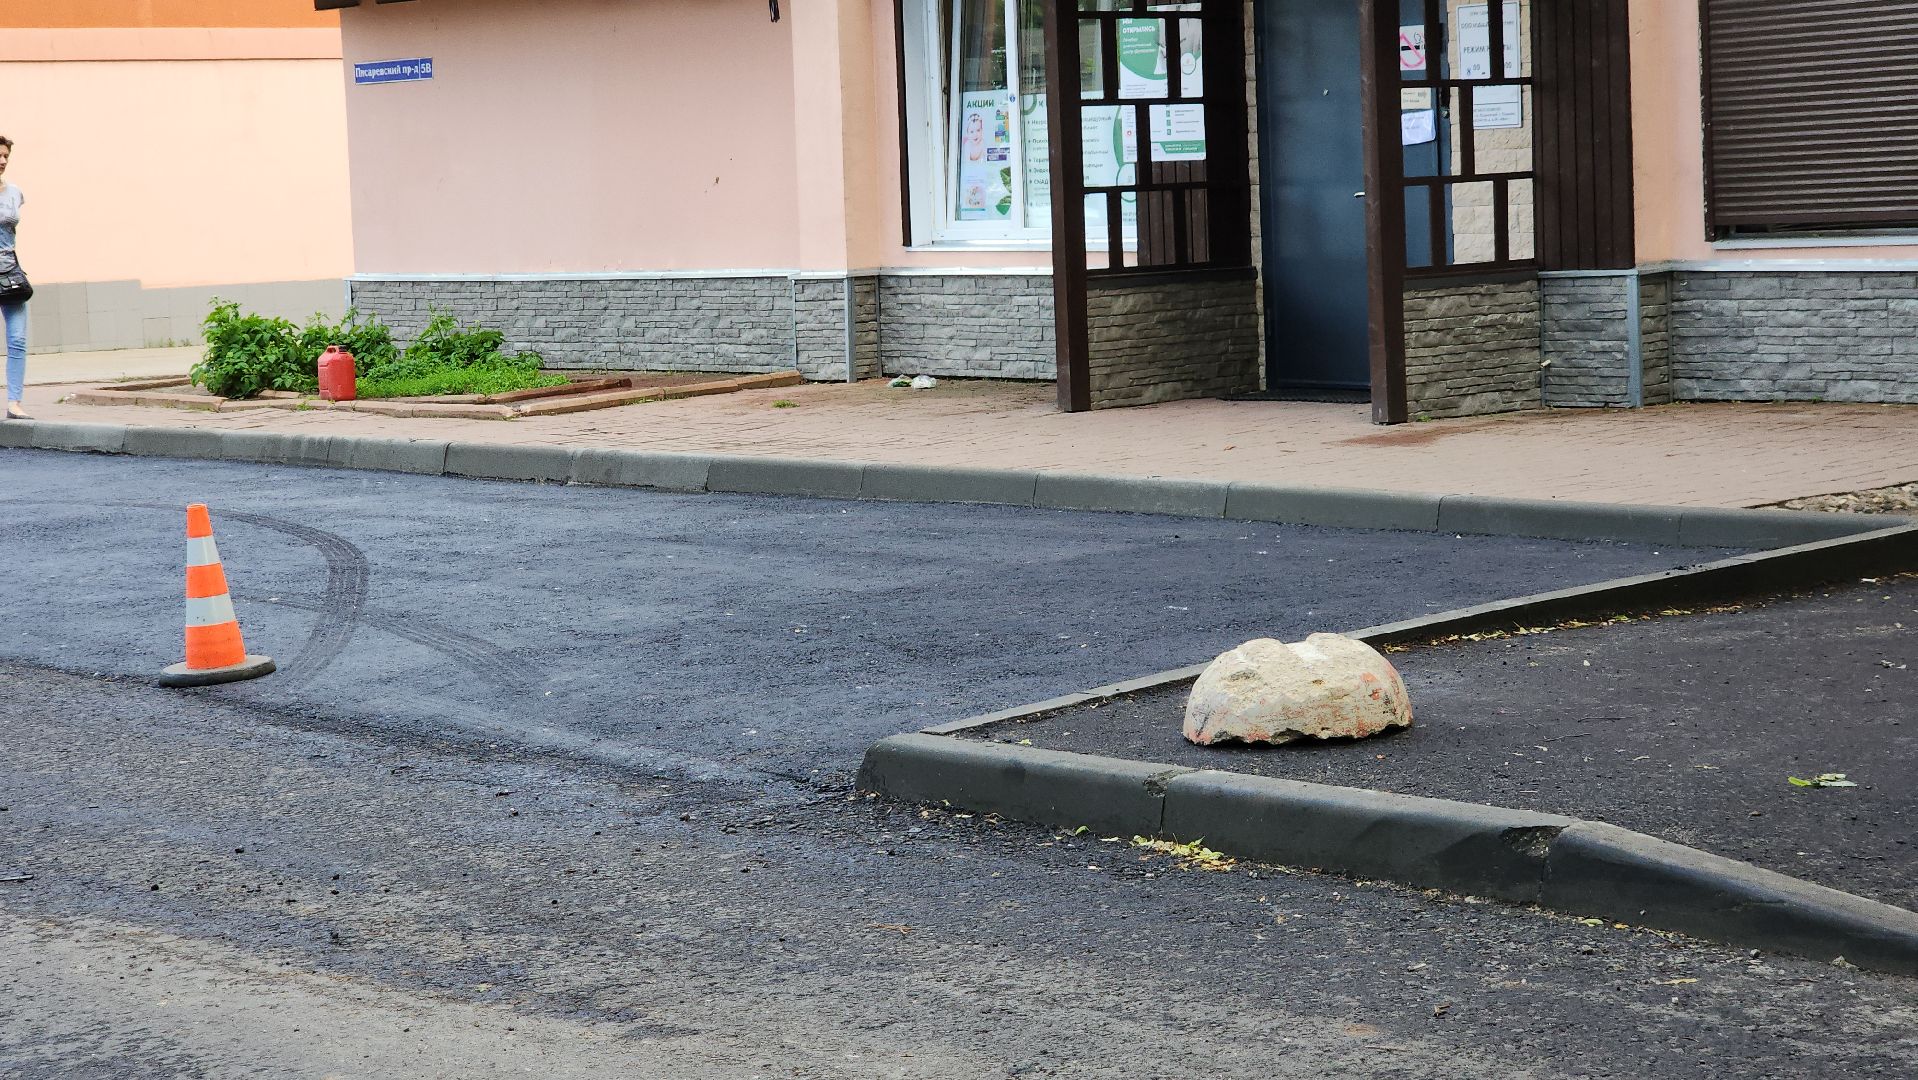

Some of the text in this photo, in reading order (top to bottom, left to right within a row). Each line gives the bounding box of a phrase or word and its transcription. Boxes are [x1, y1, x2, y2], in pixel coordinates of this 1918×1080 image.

[355, 63, 431, 78] Писаревский пр-д 5В
[966, 99, 994, 109] АКЦИИ
